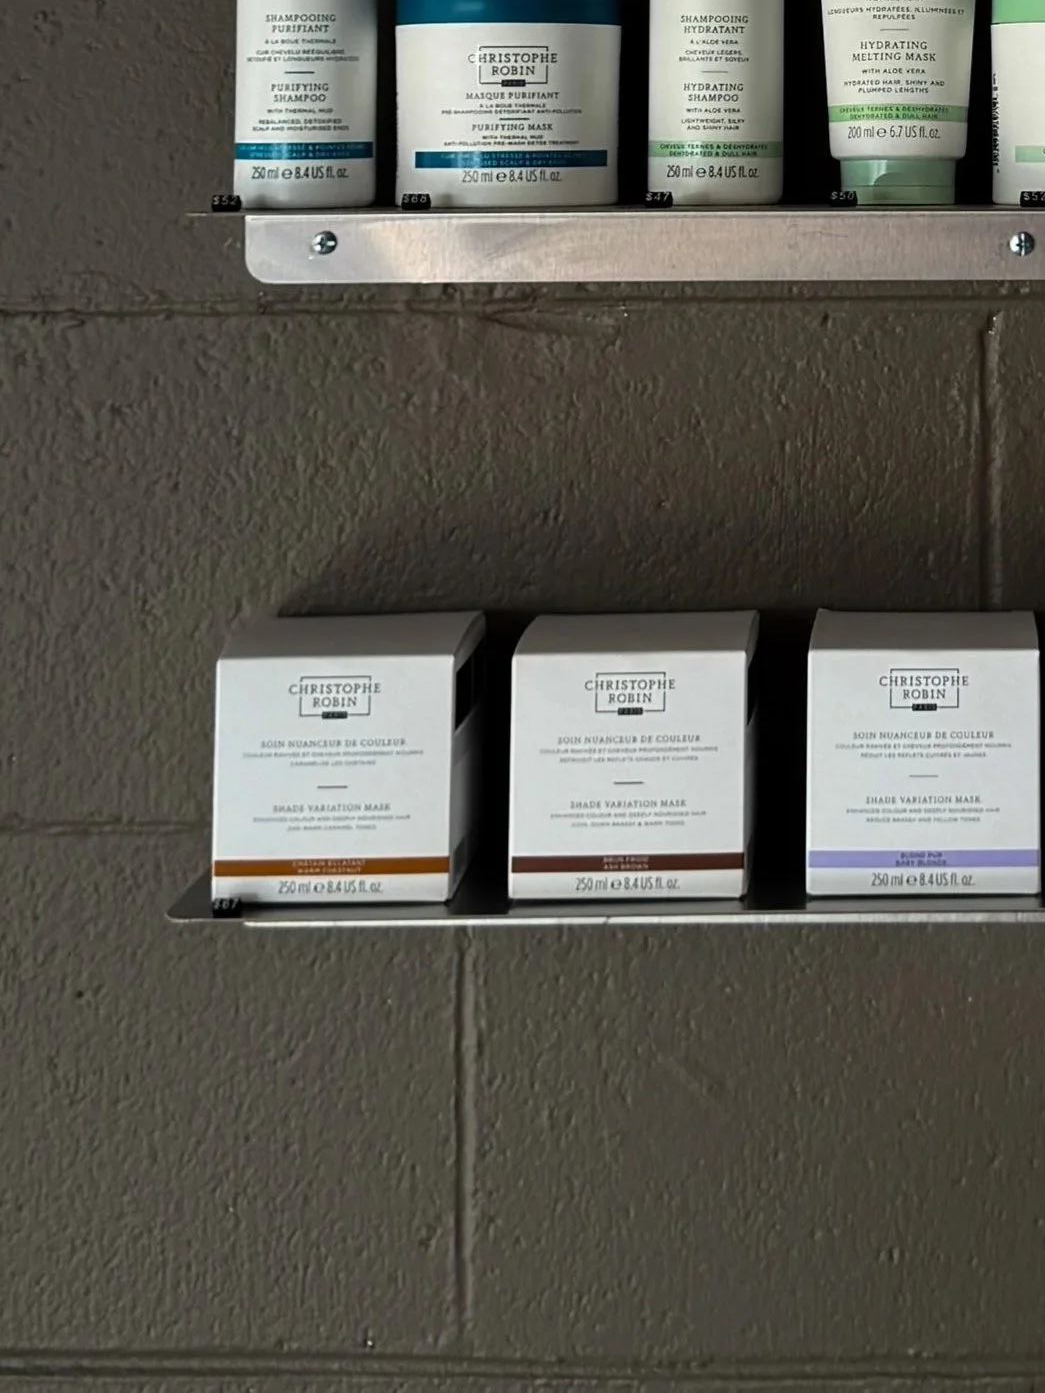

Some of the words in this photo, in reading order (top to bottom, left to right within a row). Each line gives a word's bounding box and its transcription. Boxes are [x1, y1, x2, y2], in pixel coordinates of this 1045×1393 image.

[681, 15, 748, 23] SHAMPOOING
[861, 41, 927, 50] HYDRATING
[468, 53, 558, 64] CHRISTOPHE
[852, 52, 901, 61] MELTING
[906, 52, 935, 61] MASK
[492, 66, 535, 76] ROBIN
[684, 83, 743, 91] HYDRATING
[466, 92, 505, 100] MASQUE
[688, 94, 739, 102] SHAMPOO
[528, 123, 553, 131] MASK
[848, 126, 862, 139] 200
[863, 126, 874, 138] ml
[890, 125, 903, 138] 6.7
[905, 125, 917, 138] US
[584, 679, 676, 691] CHRISTOPHE
[879, 676, 970, 687] CHRISTOPHE
[288, 683, 381, 695] CHRISTOPHE
[608, 693, 652, 704] ROBIN
[903, 689, 946, 700] ROBIN
[313, 697, 357, 708] ROBIN
